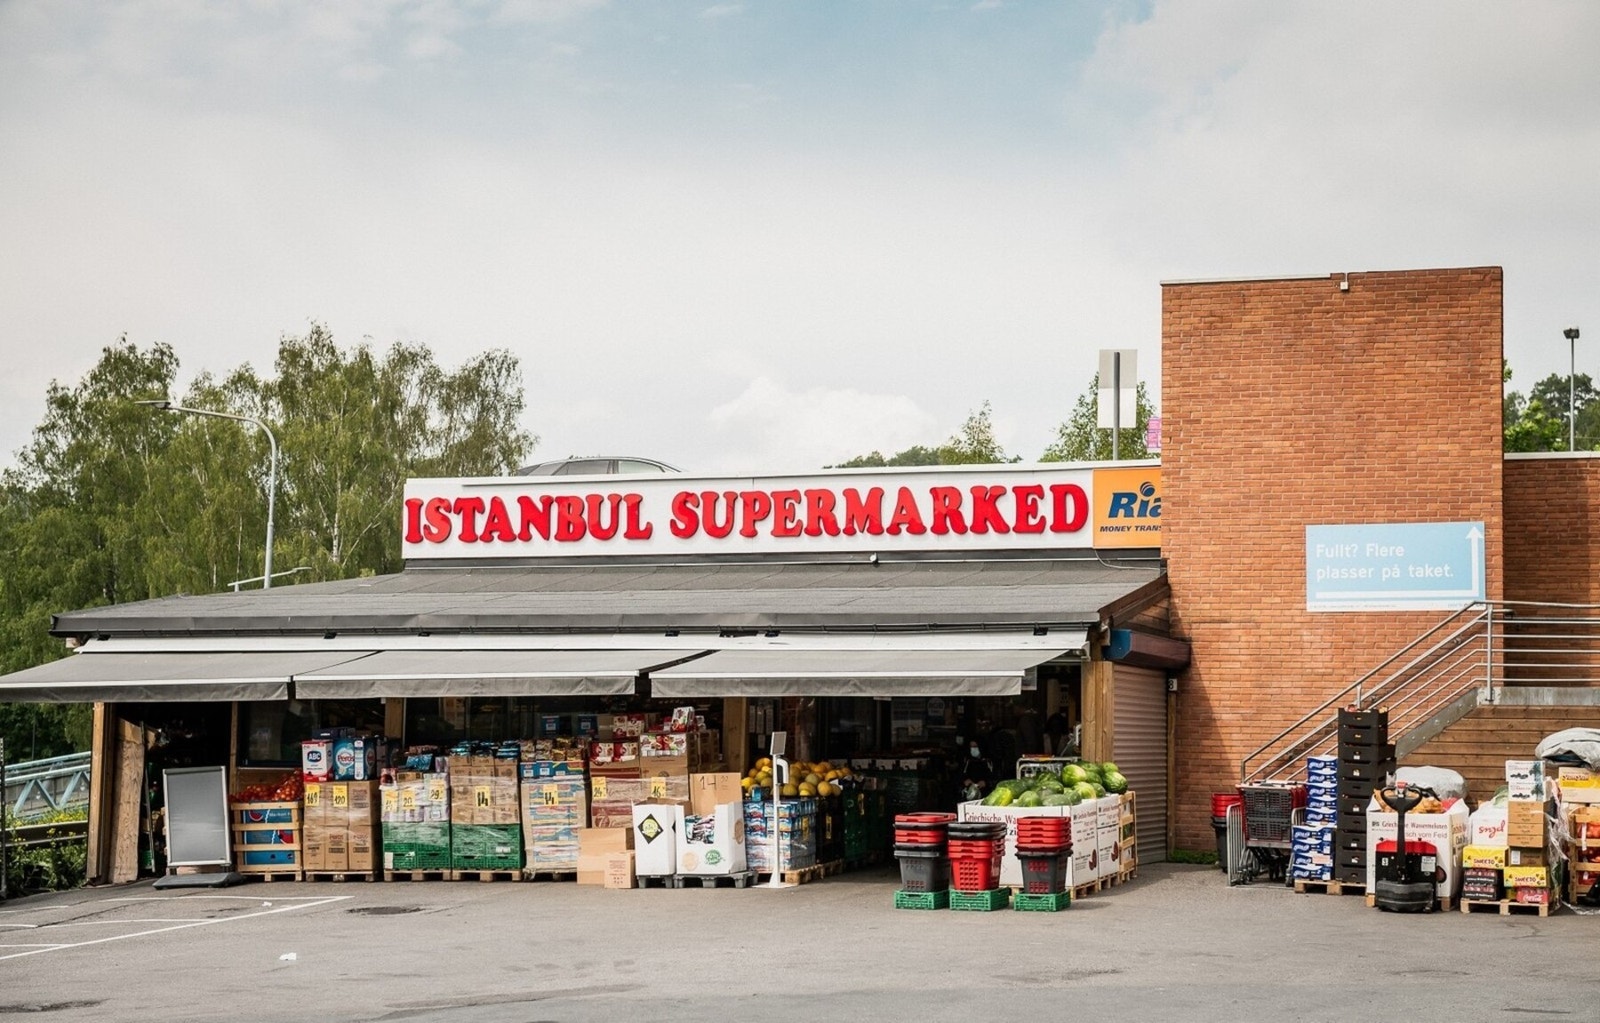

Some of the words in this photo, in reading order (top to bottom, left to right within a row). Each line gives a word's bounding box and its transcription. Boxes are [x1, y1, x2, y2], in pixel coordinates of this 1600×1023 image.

[1108, 481, 1161, 518] Ria
[405, 493, 653, 543] ISTANBUL
[669, 484, 1090, 539] SUPERMARKED
[1316, 543, 1358, 558] Fullt?
[1366, 543, 1405, 557] Flere
[1316, 565, 1374, 582] plasser
[1382, 563, 1400, 581] på
[1408, 564, 1454, 578] taket.
[308, 752, 321, 761] ABC
